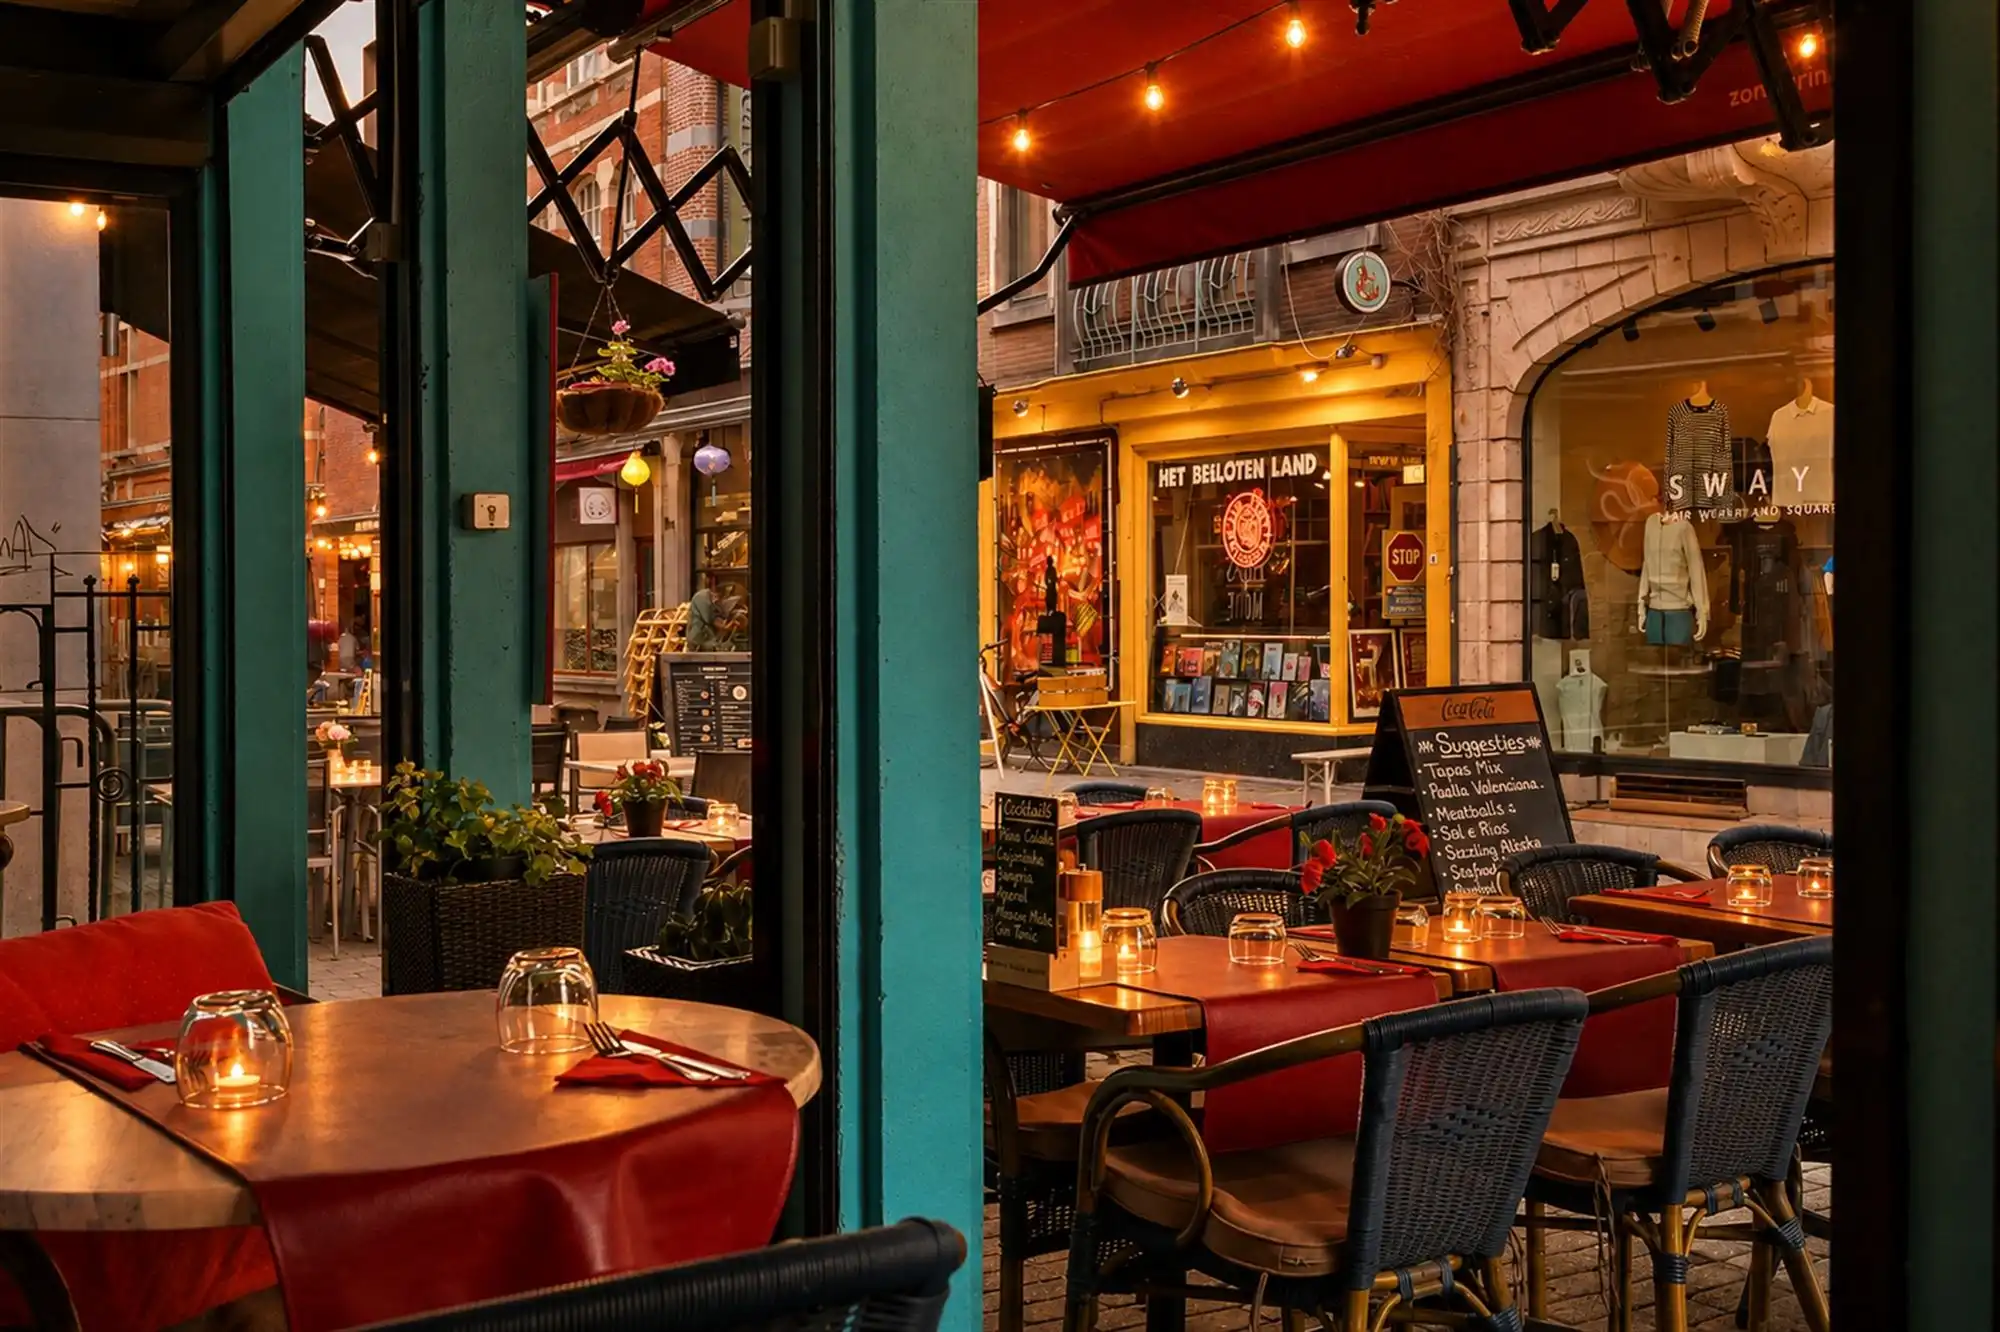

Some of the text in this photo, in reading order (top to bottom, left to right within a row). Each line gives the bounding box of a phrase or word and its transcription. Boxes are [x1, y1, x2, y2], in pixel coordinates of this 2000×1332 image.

[1158, 466, 1186, 488] HET
[1271, 452, 1317, 478] LAND
[1392, 549, 1420, 565] STOP
[1435, 732, 1526, 758] Suggesties
[1424, 761, 1504, 783] Tapas Mix
[1436, 800, 1505, 823] Meatballs
